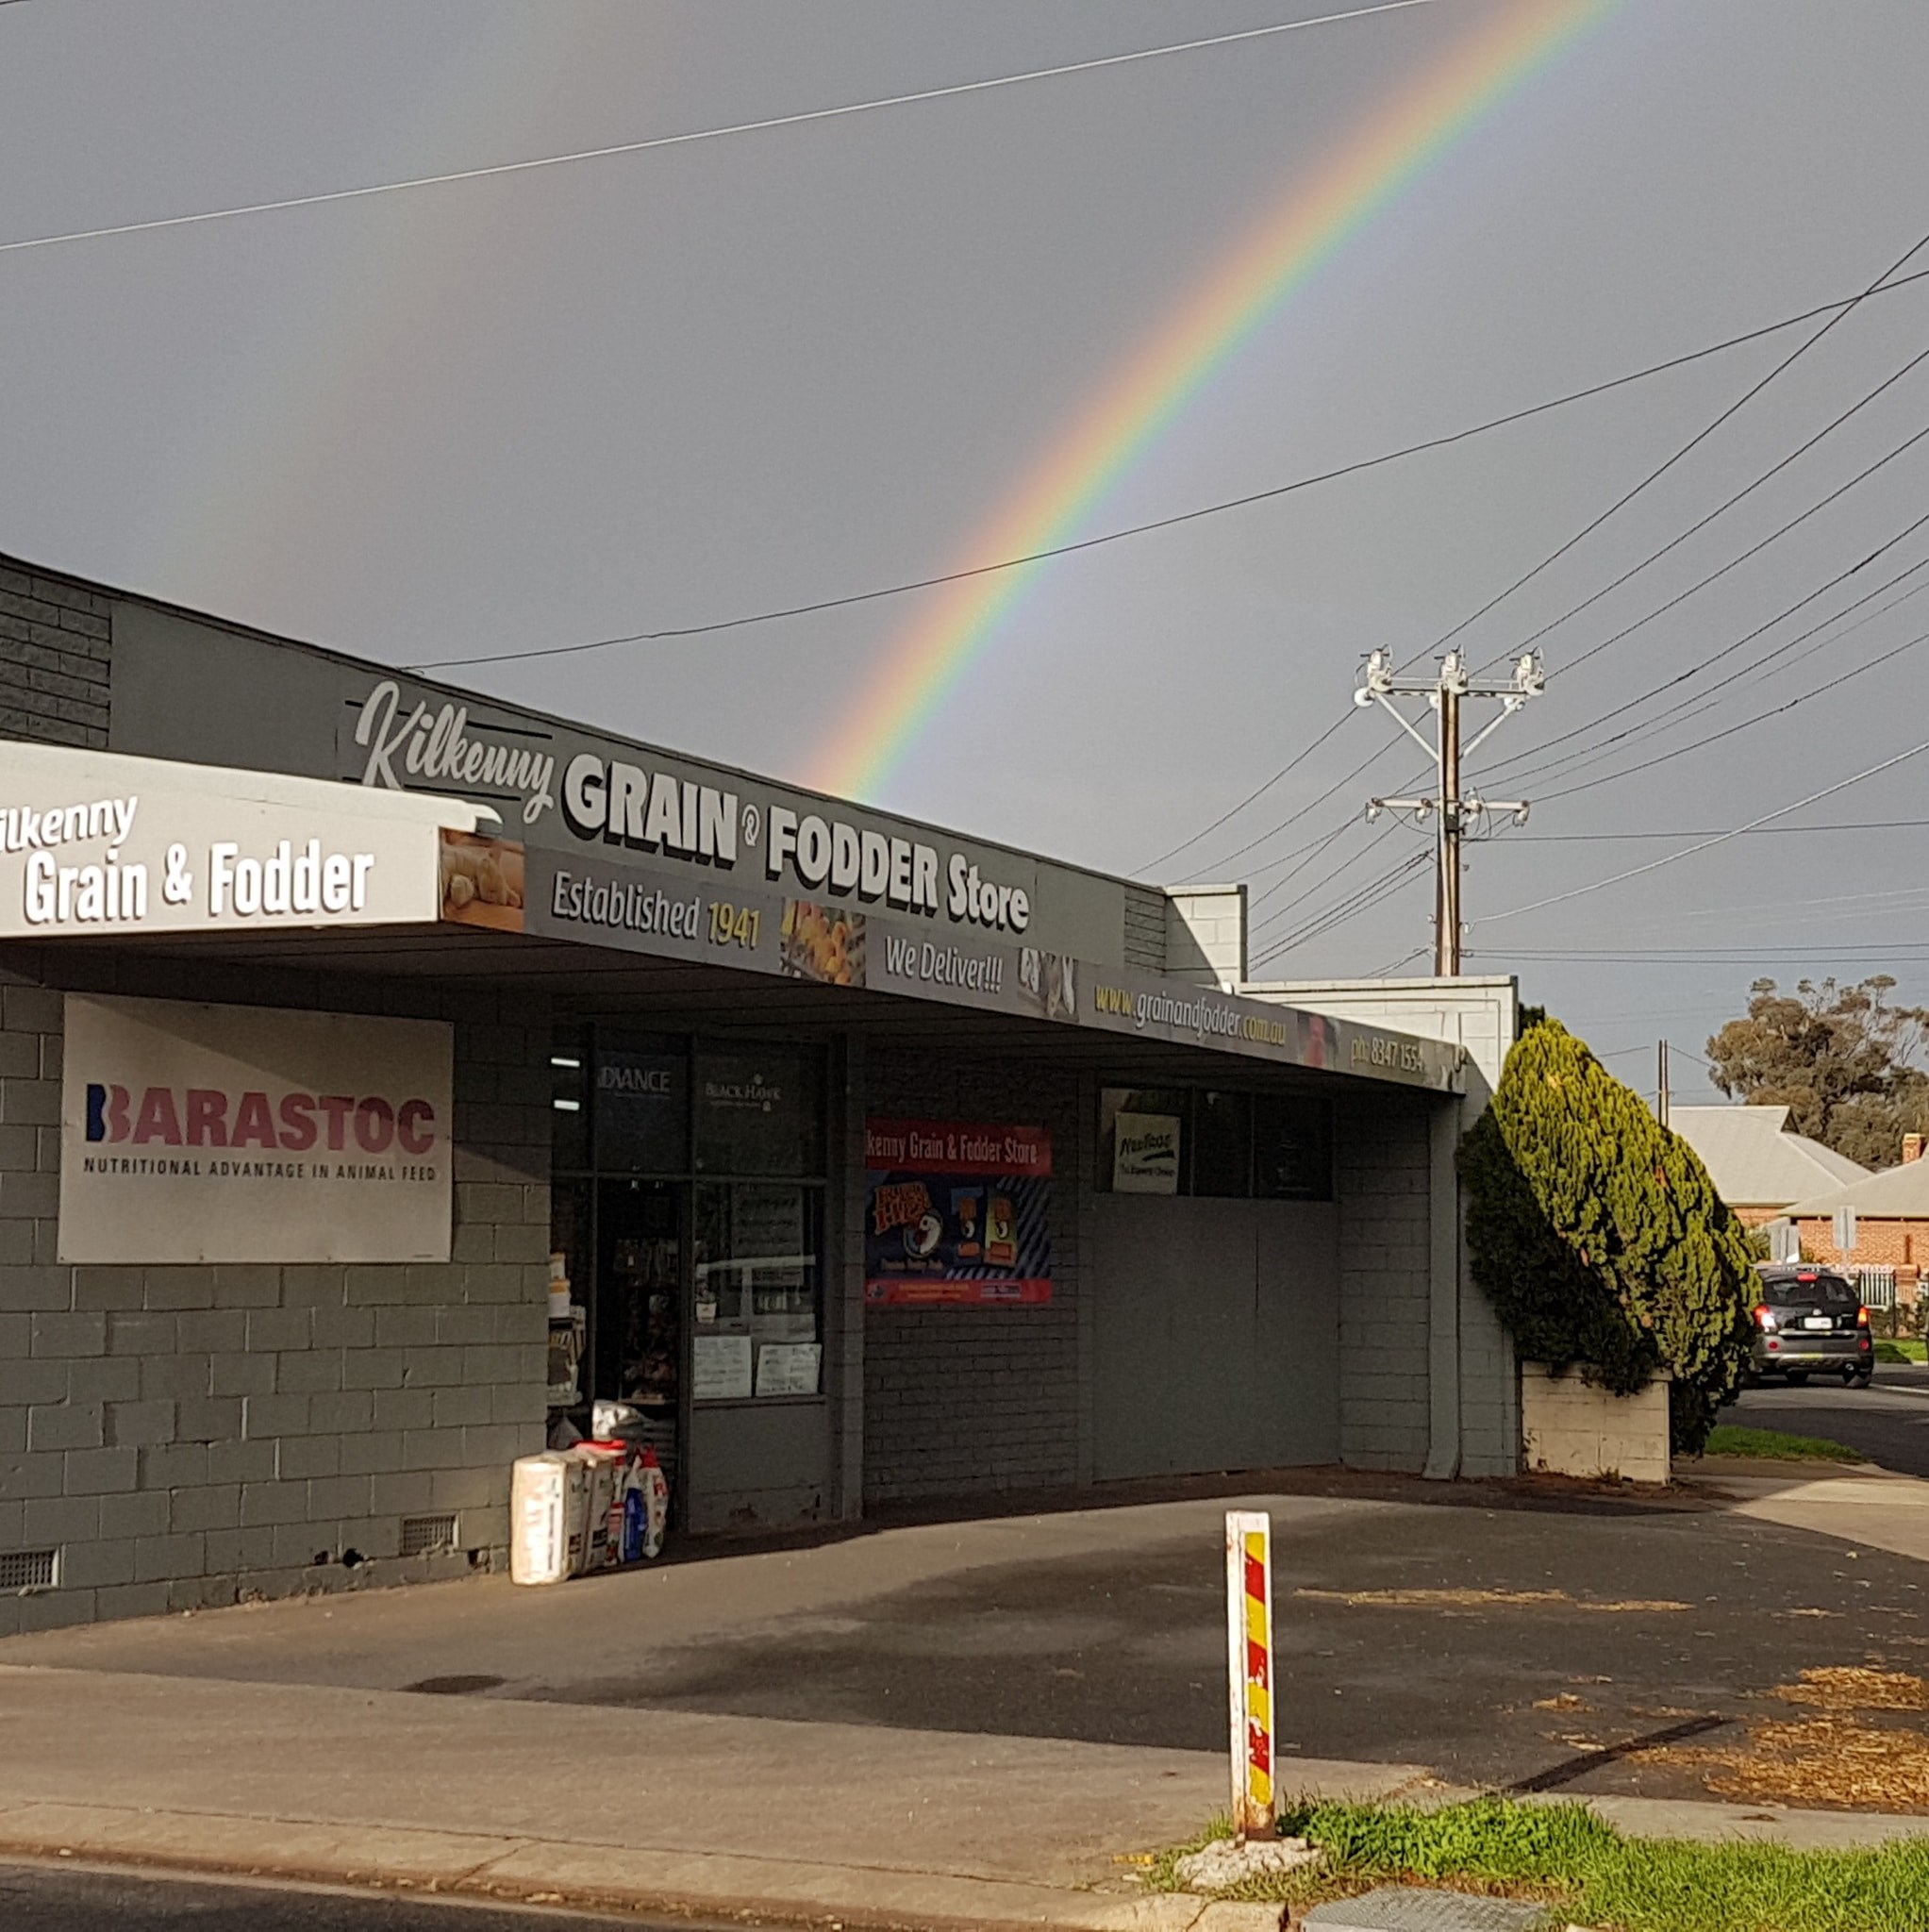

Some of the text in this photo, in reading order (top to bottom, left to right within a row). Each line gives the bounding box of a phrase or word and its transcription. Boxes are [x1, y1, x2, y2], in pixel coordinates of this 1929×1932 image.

[355, 681, 1031, 932] Kilkenny GRAIN & FODDER Store
[24, 838, 375, 924] Grain & Fodder
[552, 870, 761, 948] Established 1941
[885, 935, 1004, 994] We Deliver!!!
[1095, 984, 1288, 1048] www.grainandfodder.com.au
[1372, 1037, 1398, 1067] 8347
[85, 1083, 437, 1154] BARASTOC
[909, 1131, 944, 1159] Grain
[946, 1132, 958, 1161] &
[959, 1134, 1002, 1162] Fodder
[1004, 1137, 1039, 1164] Store
[83, 1158, 437, 1181] NUTRITIONAL ADVANTAGE IN ANIMAL FEED
